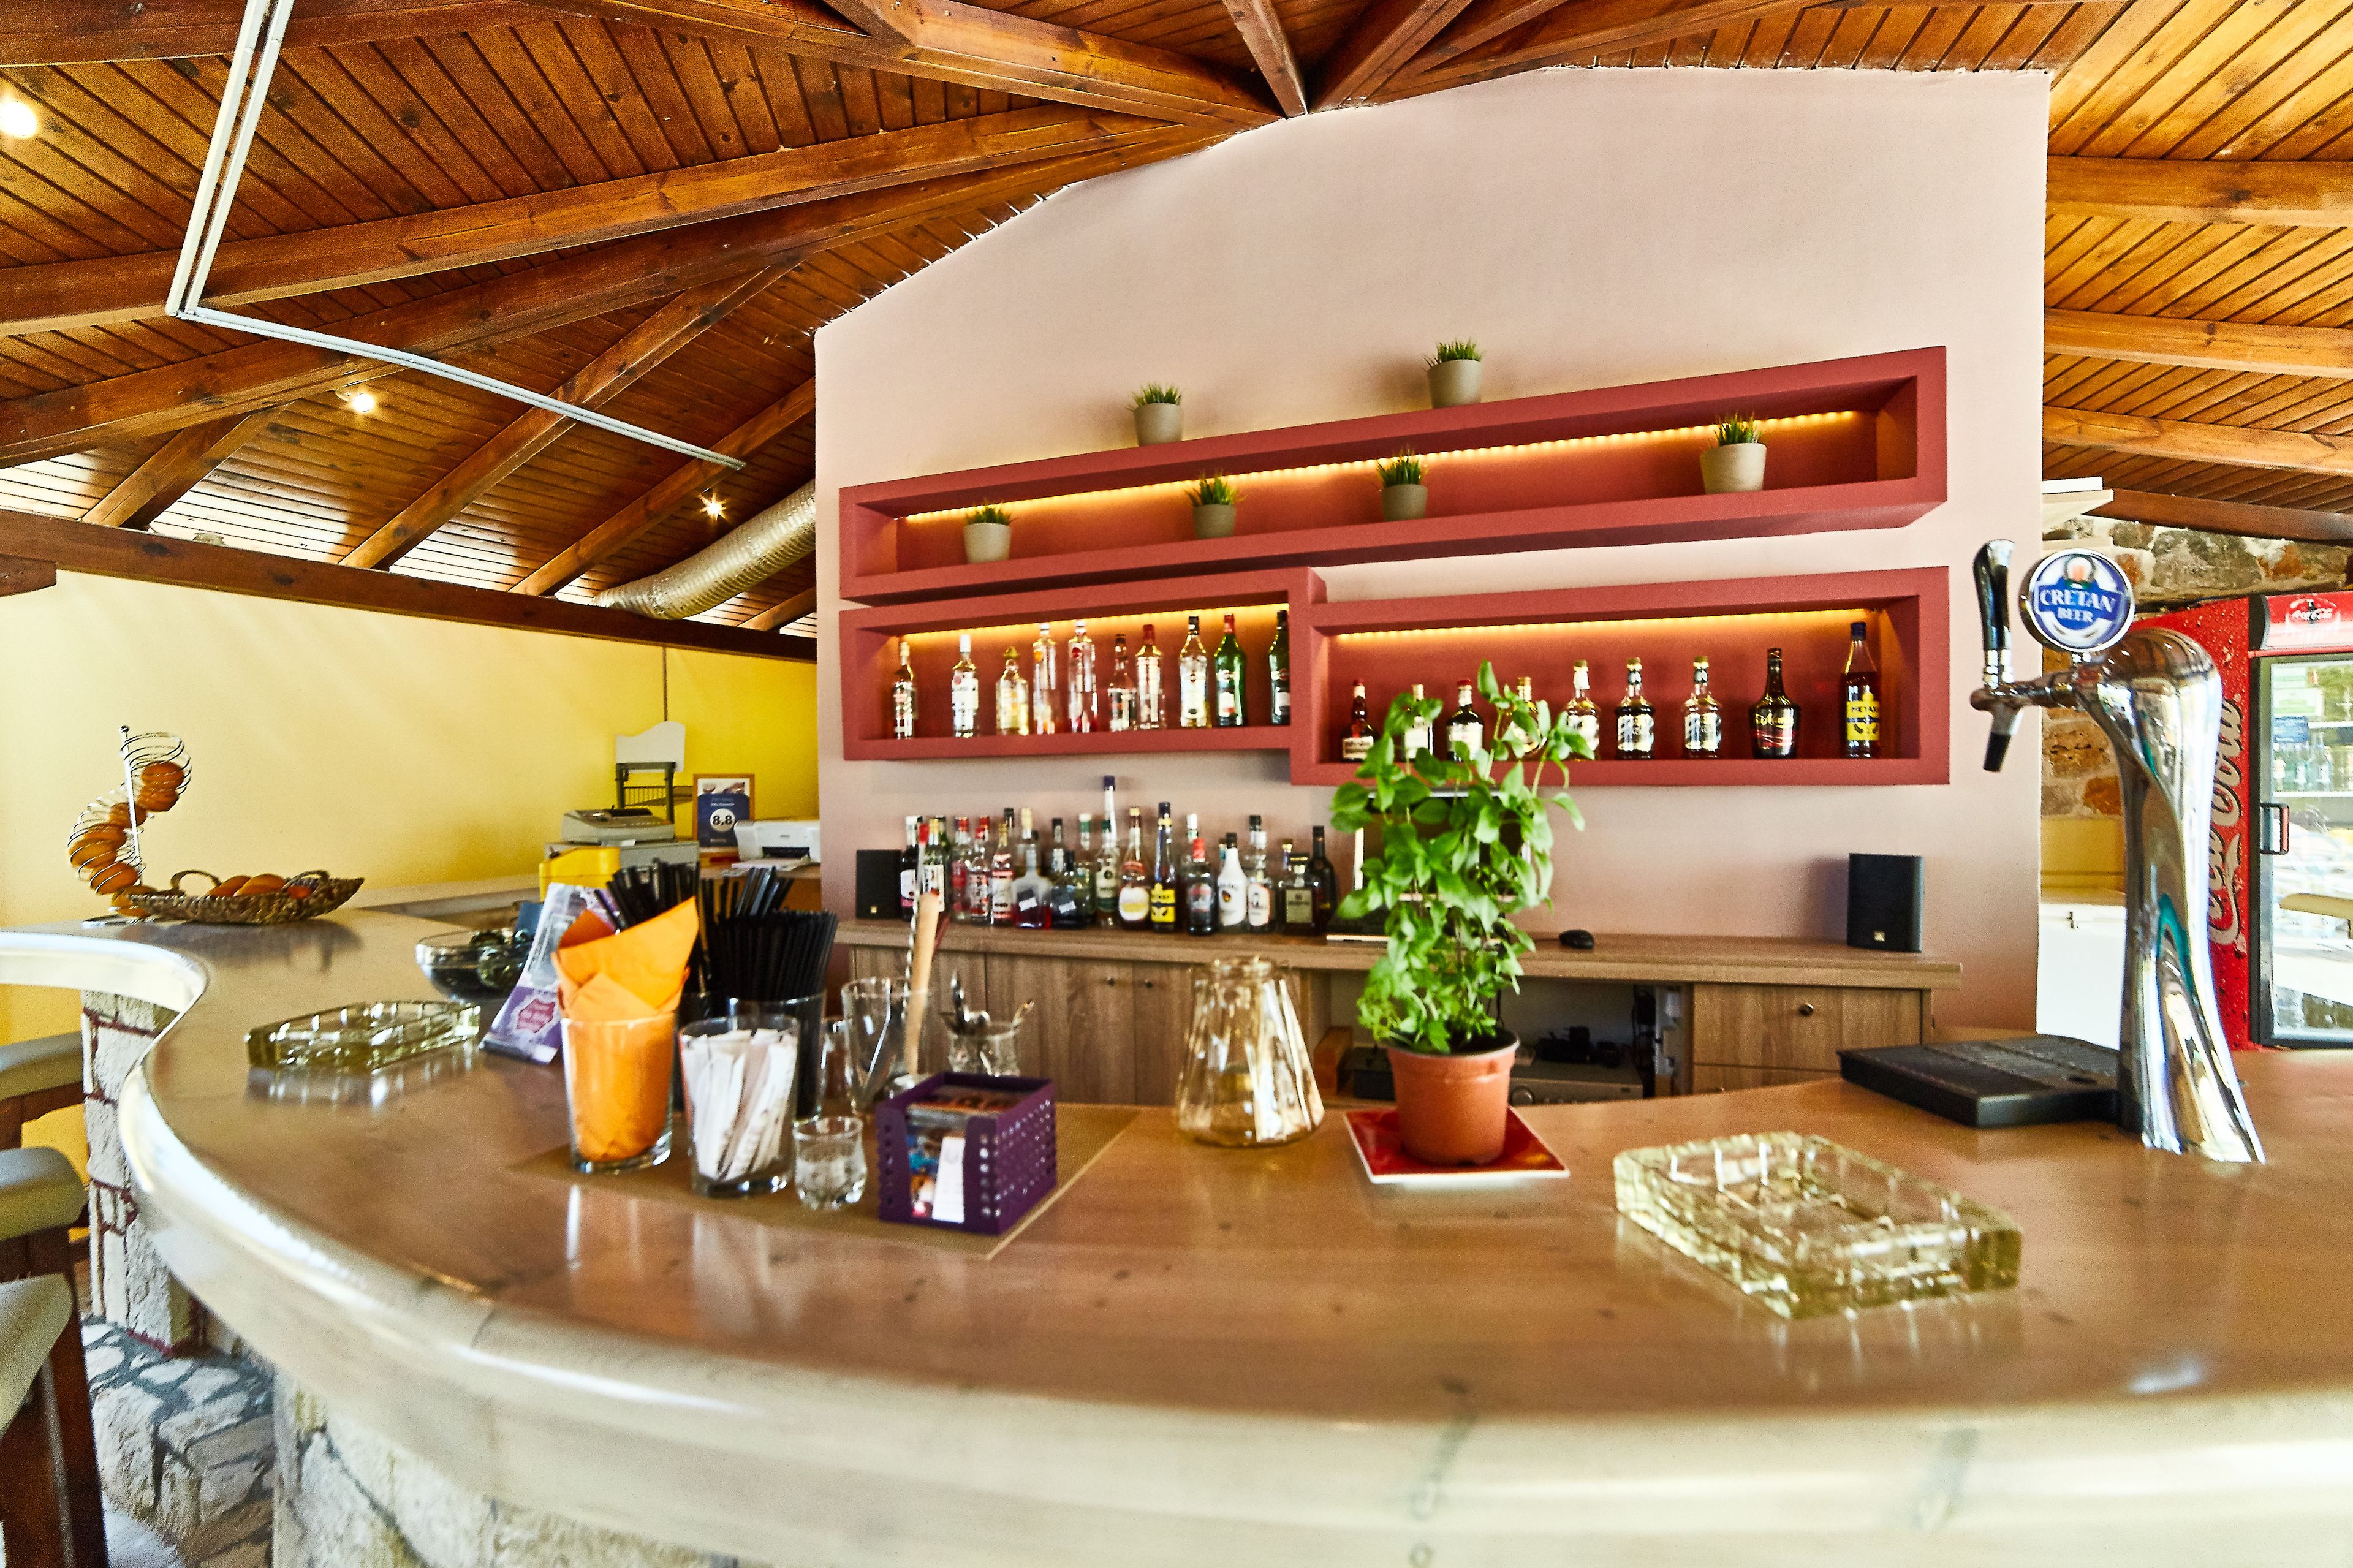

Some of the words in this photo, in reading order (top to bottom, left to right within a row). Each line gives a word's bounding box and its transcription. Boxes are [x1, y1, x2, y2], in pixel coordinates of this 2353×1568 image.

[2039, 588, 2117, 613] CRETAN
[2057, 607, 2094, 623] BEER
[712, 814, 733, 826] 8,8
